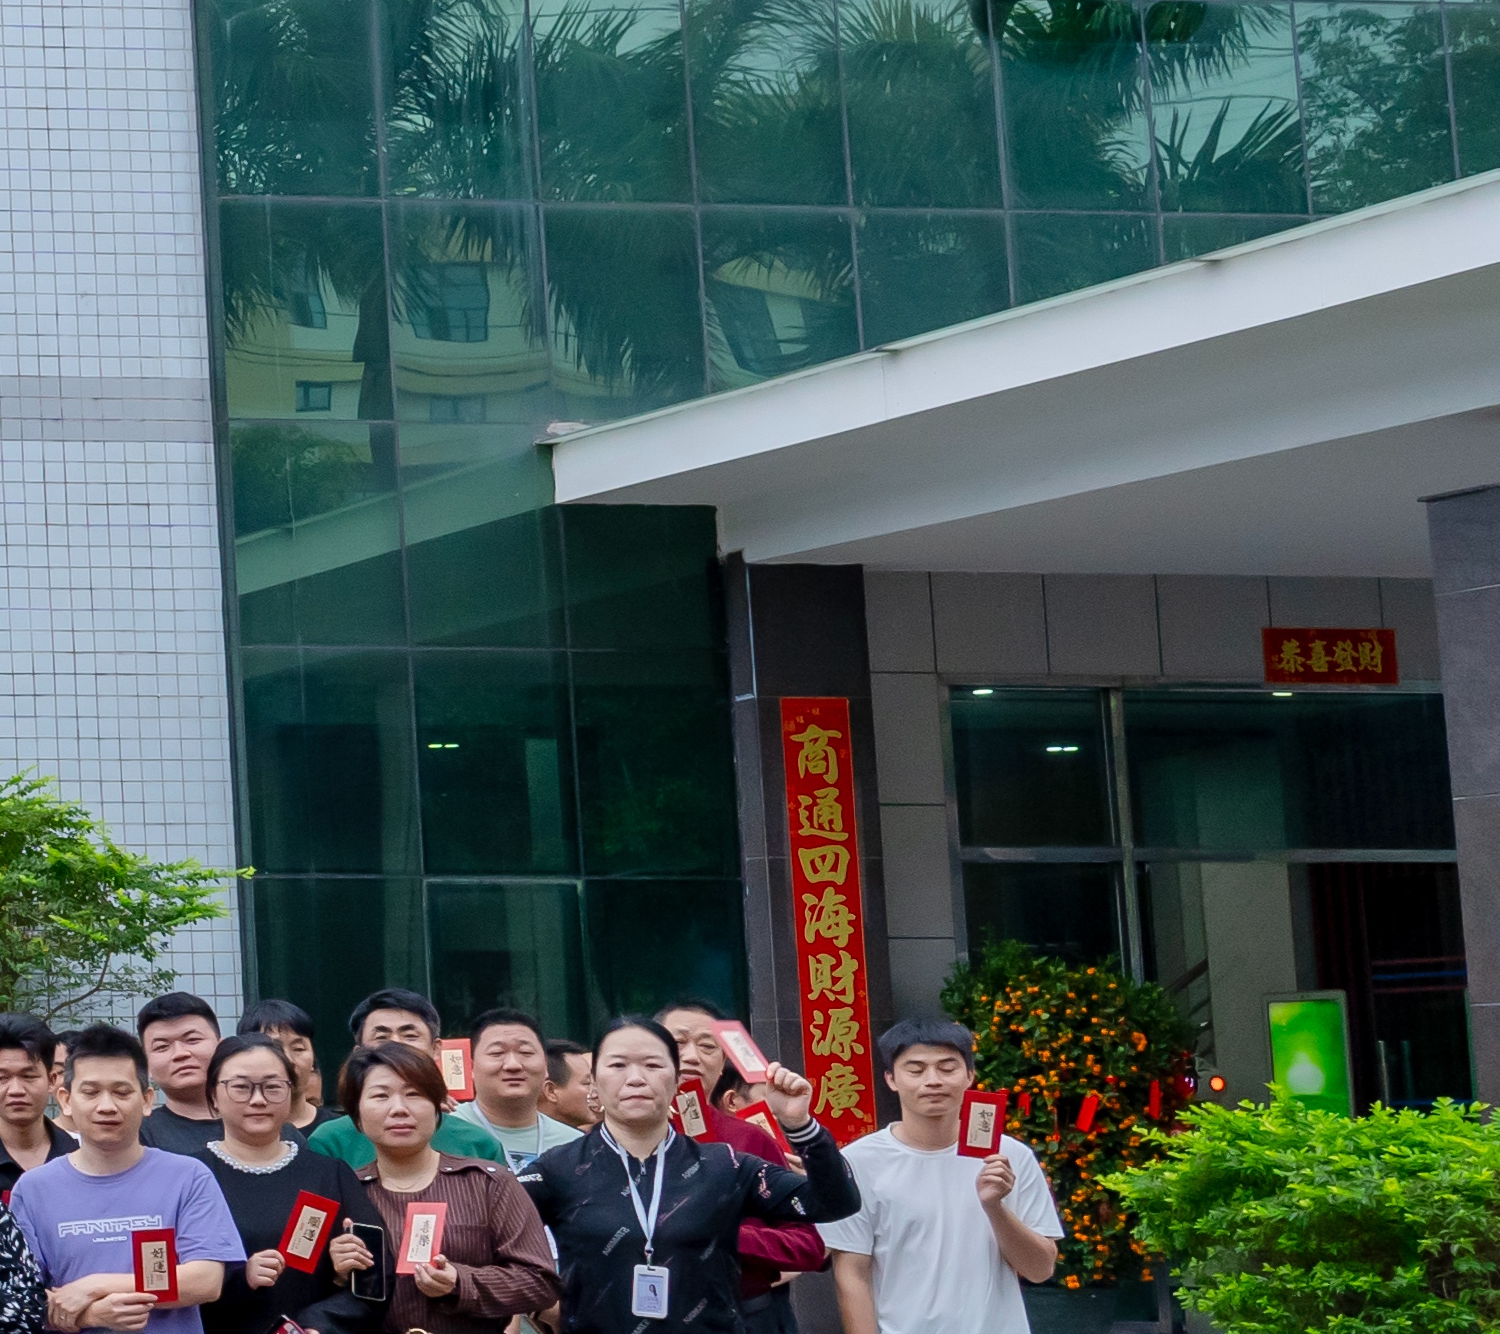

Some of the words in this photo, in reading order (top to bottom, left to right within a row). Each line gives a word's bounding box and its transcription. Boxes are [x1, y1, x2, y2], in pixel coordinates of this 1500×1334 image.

[1278, 637, 1384, 674] 恭喜發財
[788, 723, 867, 1119] 商通四海財源廣
[57, 1214, 163, 1239] FANTASY
[151, 1247, 167, 1273] 好運
